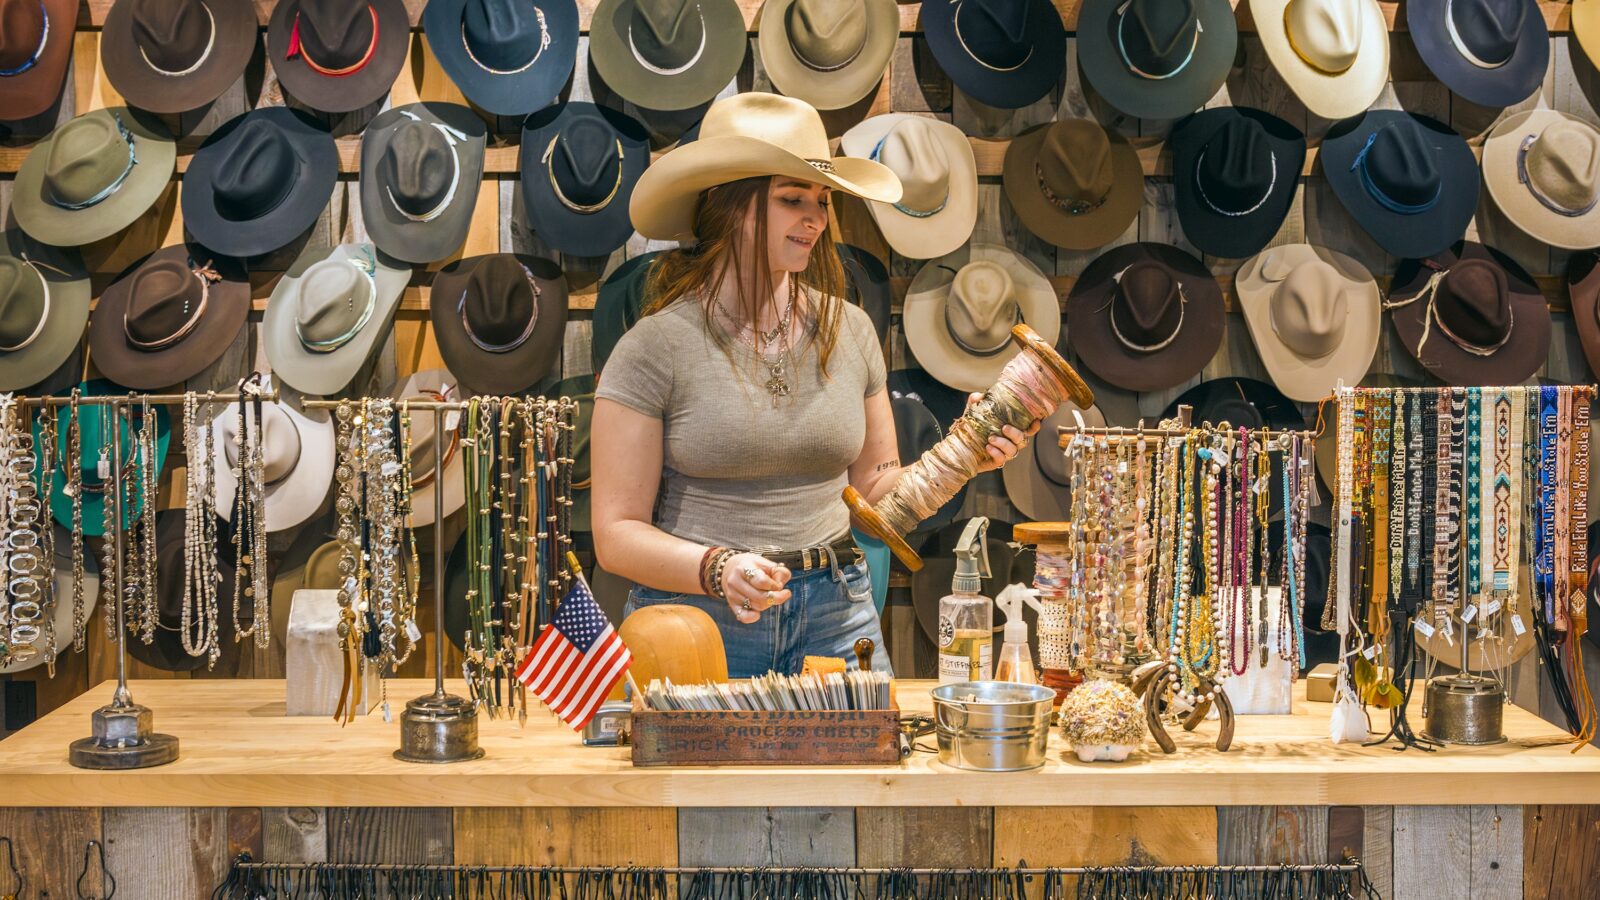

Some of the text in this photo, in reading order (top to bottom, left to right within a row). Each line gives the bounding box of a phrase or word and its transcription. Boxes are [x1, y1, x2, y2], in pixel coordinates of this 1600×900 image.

[1543, 438, 1556, 471] Stole
[1573, 432, 1588, 466] Stole
[1407, 433, 1423, 535] Don't Fence Me In
[1543, 471, 1556, 492] You
[1572, 467, 1588, 489] You
[1390, 448, 1405, 548] Don't Fence Me In
[1571, 544, 1587, 572] Ride
[723, 725, 806, 737] PROCESS
[813, 725, 881, 738] CHEESE
